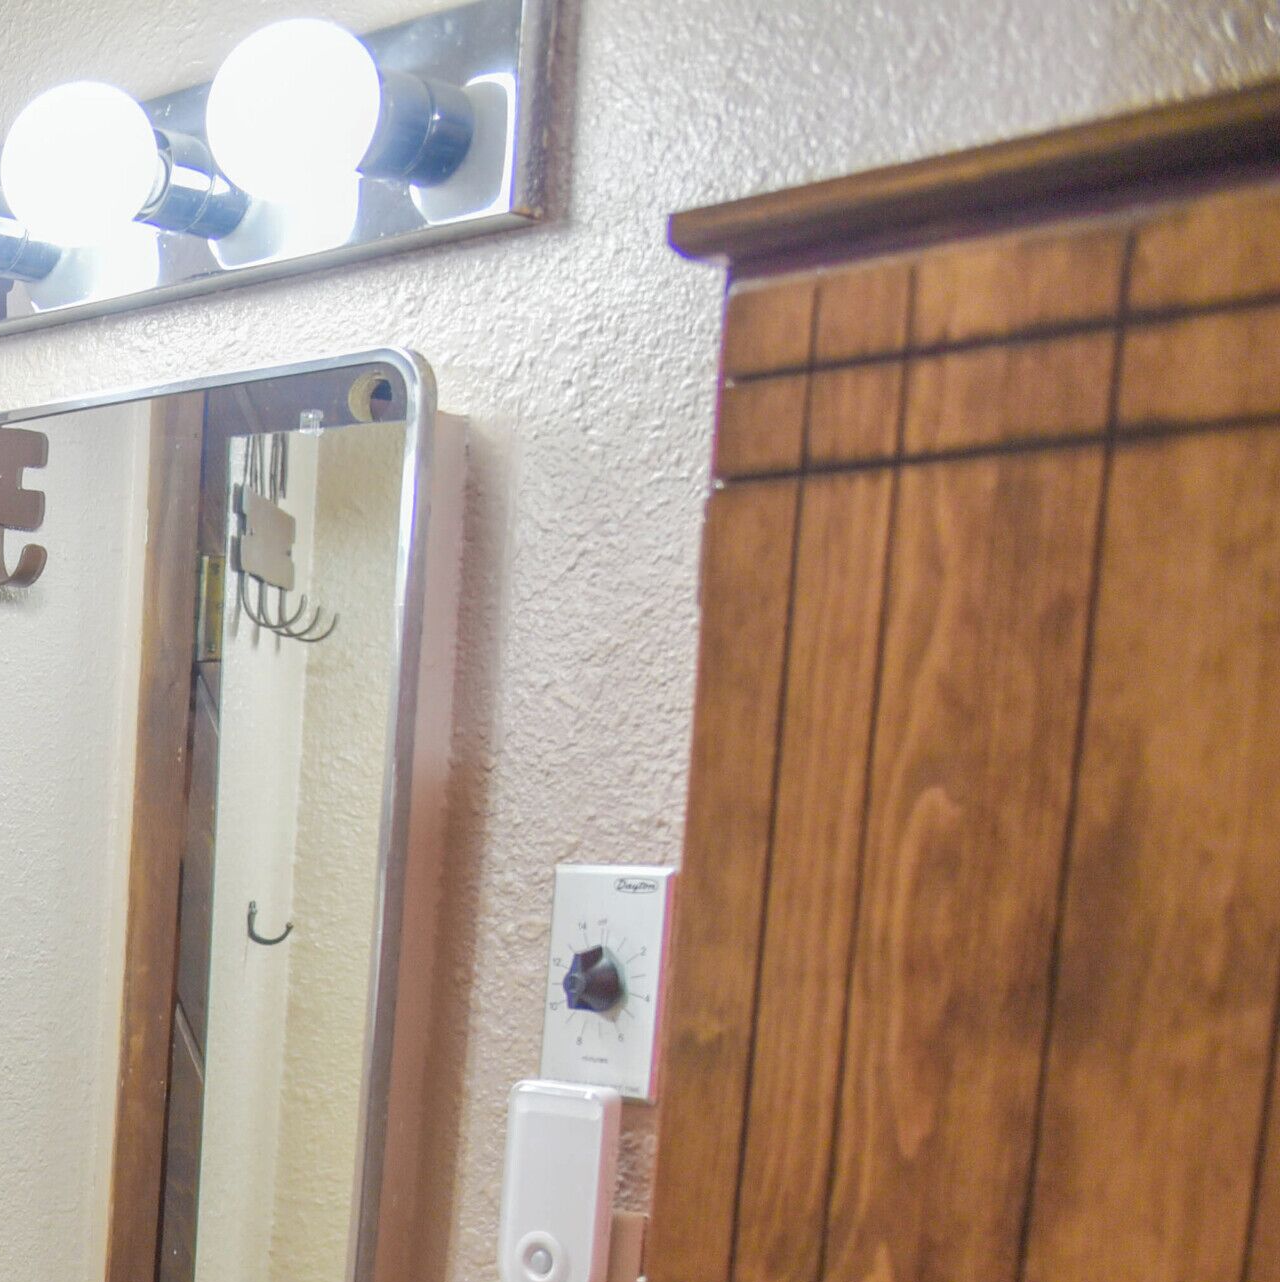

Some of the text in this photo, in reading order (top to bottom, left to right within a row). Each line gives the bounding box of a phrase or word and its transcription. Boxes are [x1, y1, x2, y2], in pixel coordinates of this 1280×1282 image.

[616, 879, 657, 893] Dayton
[640, 944, 648, 957] 2
[552, 957, 562, 967] 12
[576, 1036, 583, 1046] 8
